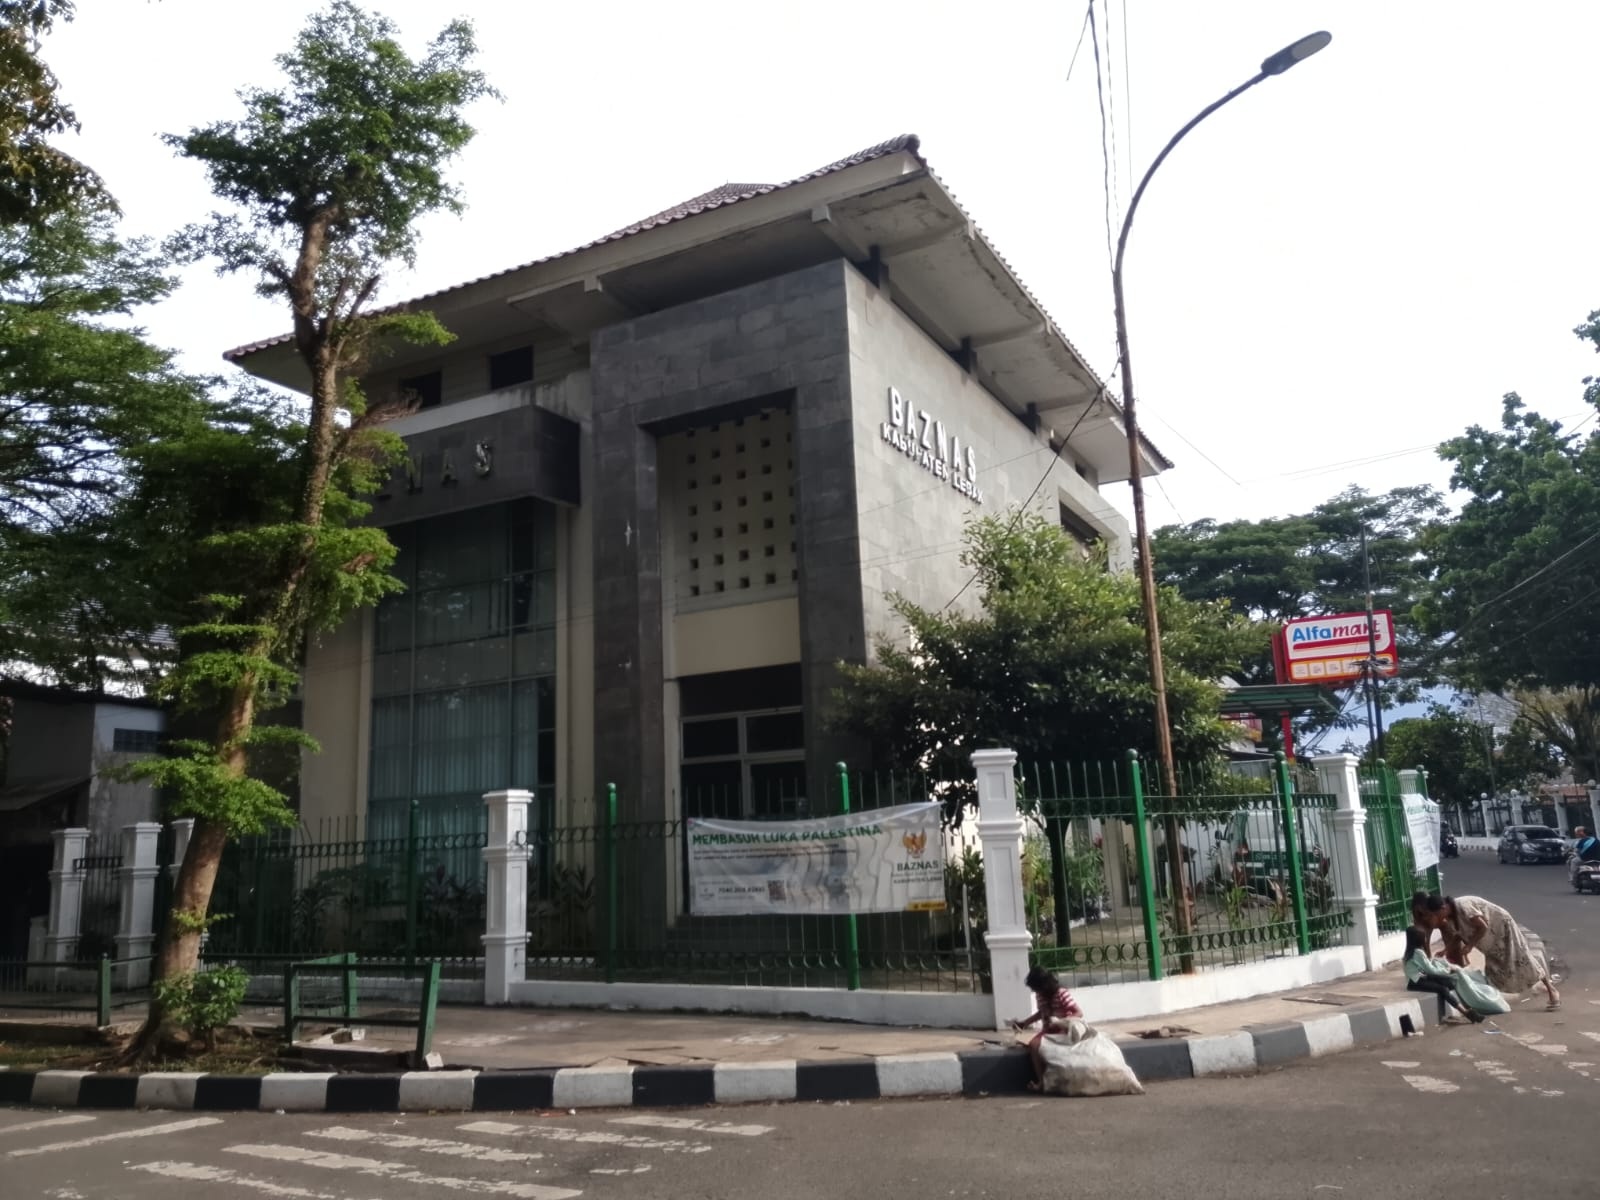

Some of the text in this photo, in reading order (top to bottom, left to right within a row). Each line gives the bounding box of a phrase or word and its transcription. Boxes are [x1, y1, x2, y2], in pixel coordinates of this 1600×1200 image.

[888, 385, 977, 483] BAZNAS
[1292, 619, 1381, 642] Alfamart
[692, 824, 883, 846] MEMBASUH LUKA PALESTINA
[897, 860, 939, 872] BAZNAS
